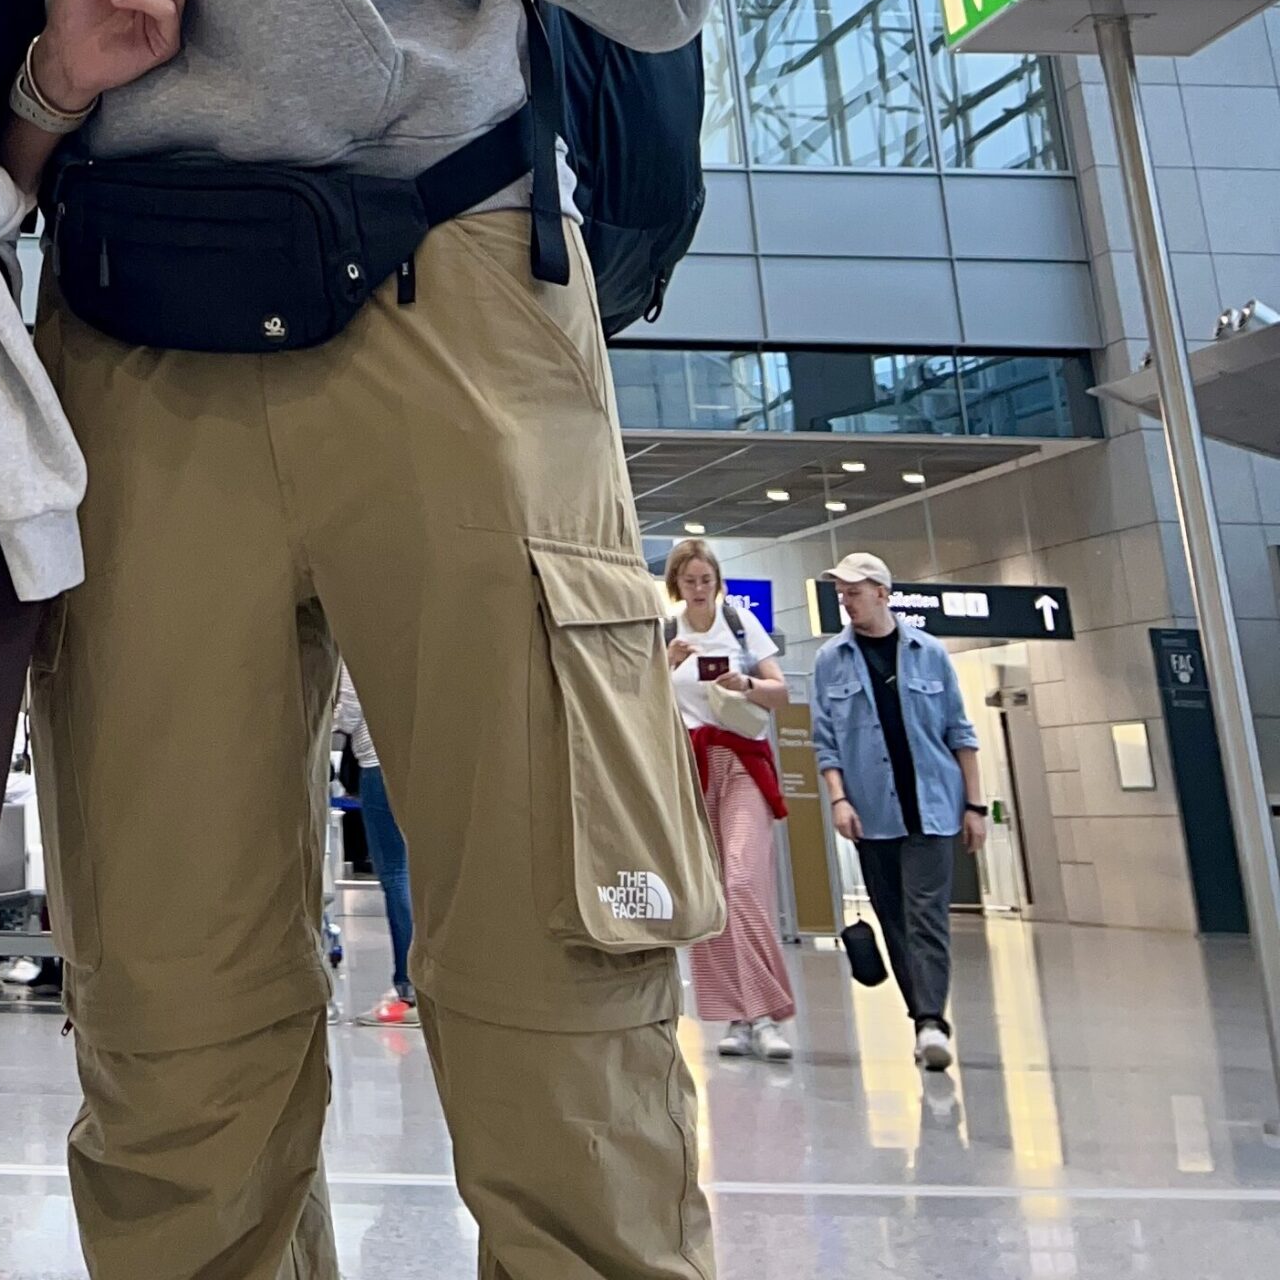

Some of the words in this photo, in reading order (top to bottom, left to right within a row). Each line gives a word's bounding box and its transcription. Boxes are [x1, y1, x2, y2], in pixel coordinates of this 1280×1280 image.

[617, 871, 647, 887] THE
[597, 886, 647, 903] NORTH
[612, 903, 646, 919] FACE
